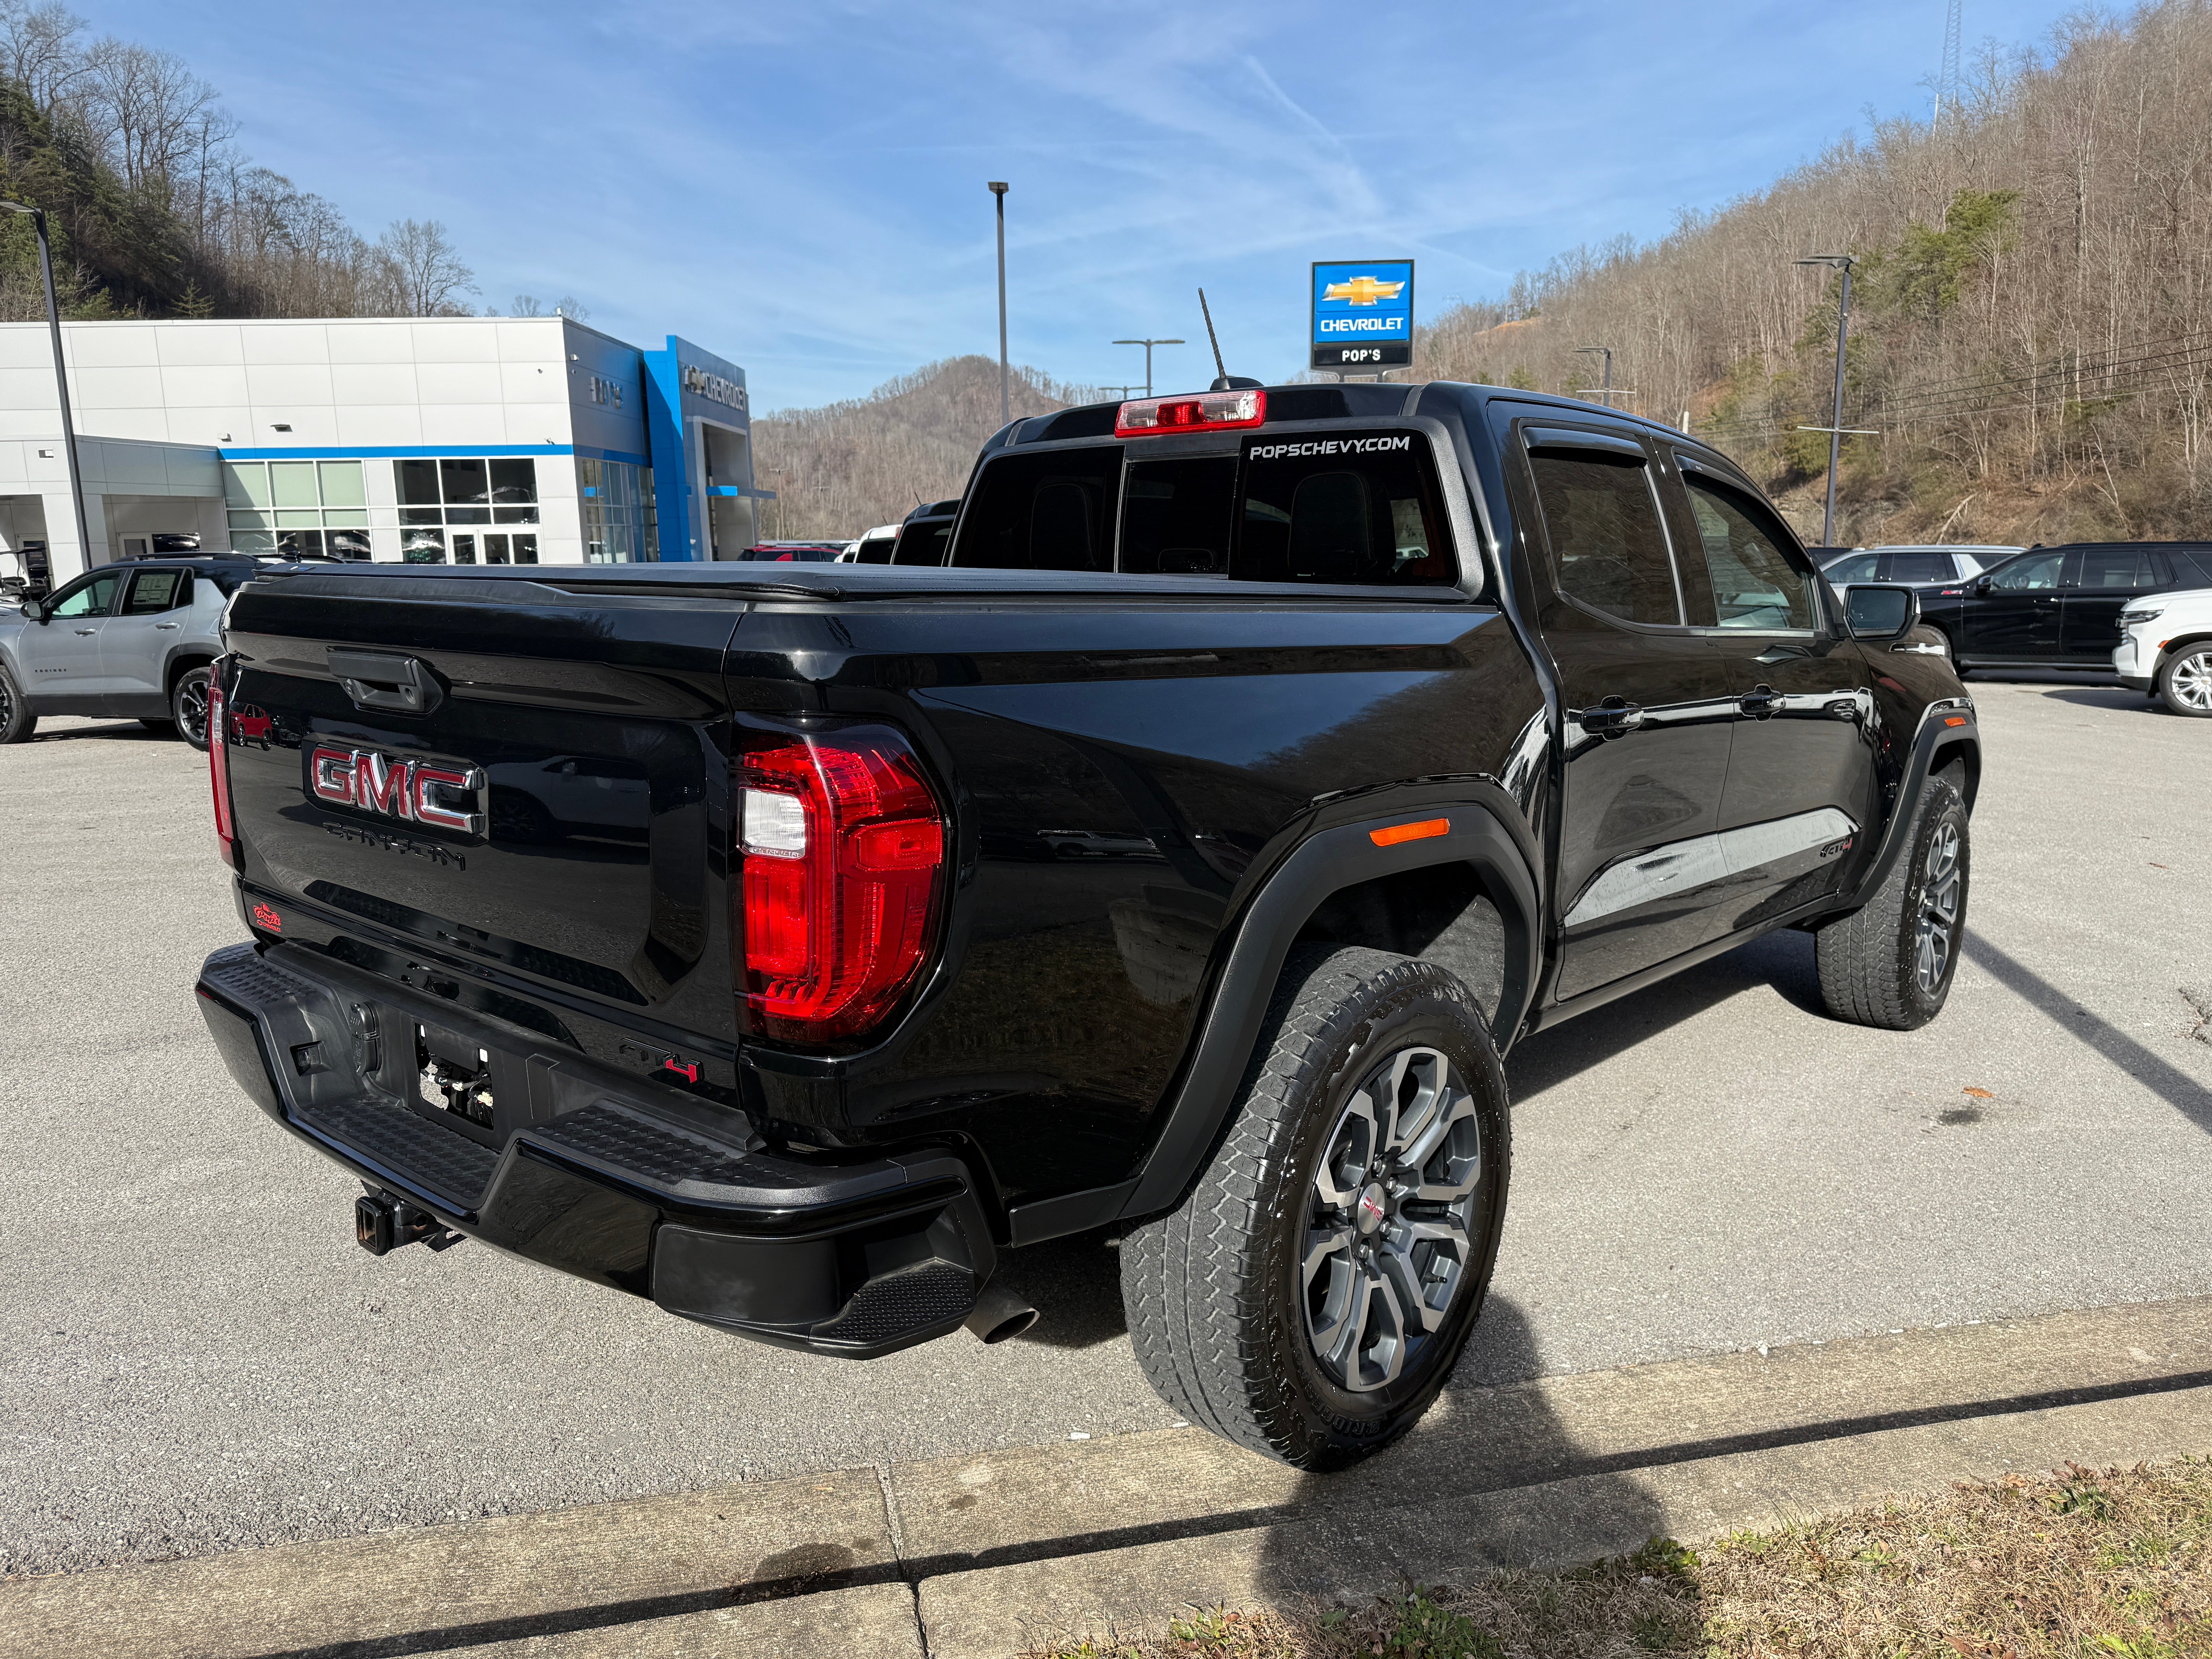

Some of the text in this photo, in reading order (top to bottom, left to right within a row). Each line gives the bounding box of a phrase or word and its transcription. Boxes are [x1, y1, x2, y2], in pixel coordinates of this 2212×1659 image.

[1321, 318, 1404, 332] CHEVROLET
[1342, 349, 1381, 362] POP'S
[706, 372, 745, 412] CHEVROLET
[1250, 436, 1410, 460] POPSCHEVY.COM
[312, 742, 486, 835] GMC
[619, 1037, 705, 1084] AT4
